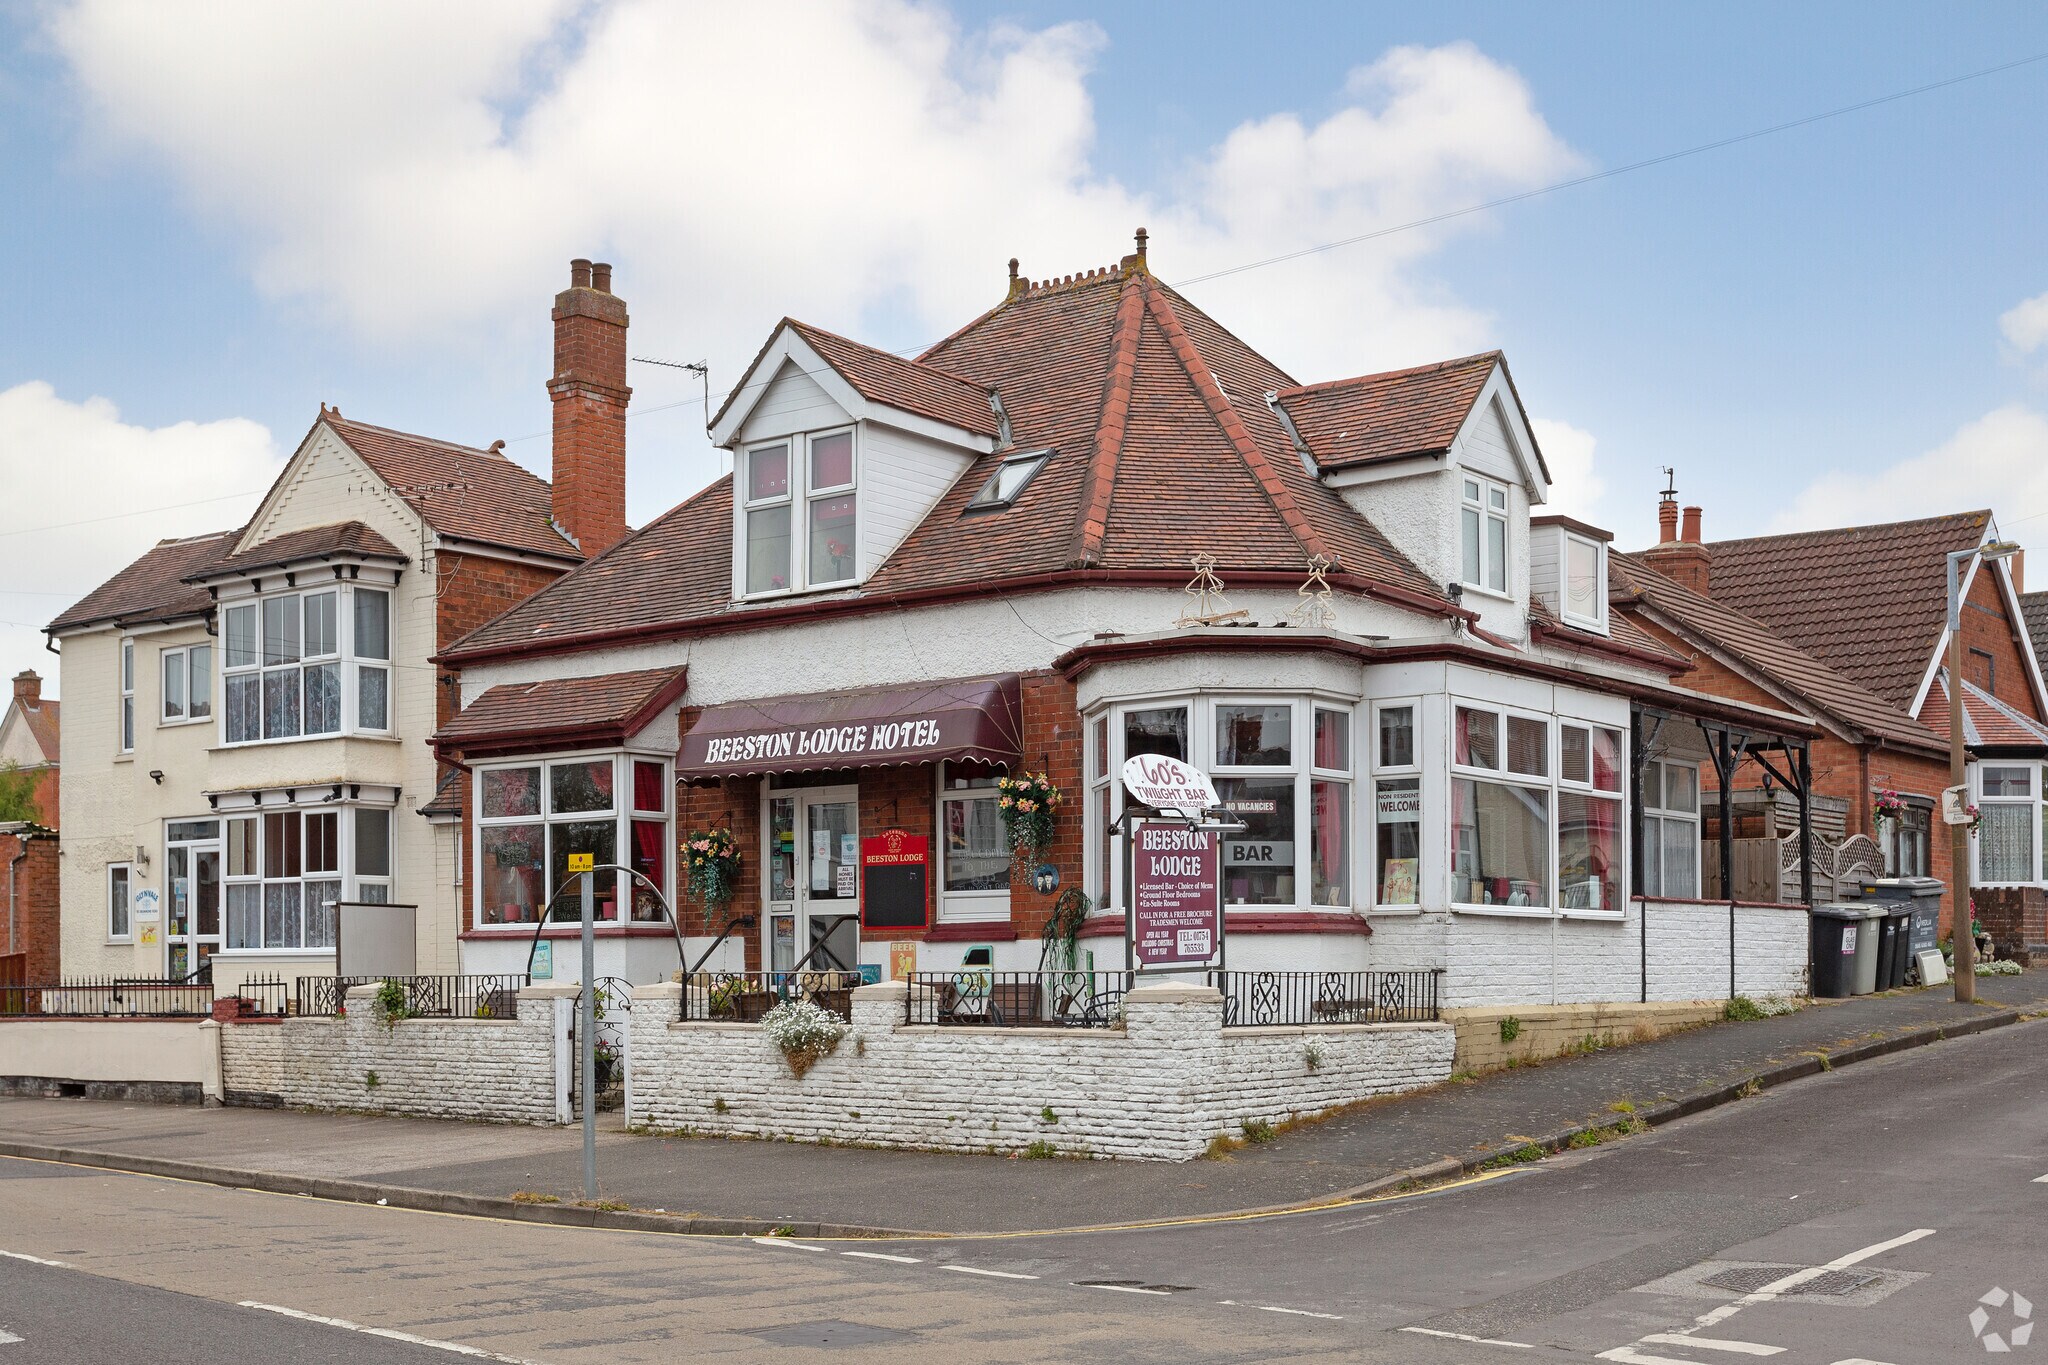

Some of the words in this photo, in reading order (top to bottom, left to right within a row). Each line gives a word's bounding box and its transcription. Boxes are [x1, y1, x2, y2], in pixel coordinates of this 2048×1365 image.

[704, 731, 796, 764] BEESTON
[796, 725, 867, 756] LODGE
[869, 719, 940, 750] HOTEL
[1183, 788, 1210, 801] BAR
[1146, 800, 1177, 808] EVERYONE
[1177, 800, 1207, 808] WELCOME
[1225, 802, 1236, 810] NO
[1237, 801, 1275, 811] VACANCIES
[1380, 800, 1420, 812] WELCOME
[1142, 829, 1209, 851] BEESTON
[866, 855, 899, 863] BEESTON
[900, 853, 924, 862] LODGE
[1232, 845, 1274, 862] BAR
[1151, 855, 1202, 877] LODGE
[1142, 882, 1164, 890] Licensed
[1165, 882, 1175, 890] Bar
[1177, 881, 1194, 890] Choice
[1194, 881, 1200, 889] of
[1200, 881, 1214, 889] Menu
[1142, 891, 1162, 899] Ground
[1176, 890, 1201, 898] Bedrooms
[1142, 900, 1163, 908] En-Suite
[1163, 899, 1180, 907] Rooms
[1139, 911, 1152, 919] CALL
[1153, 911, 1159, 919] IN
[1174, 910, 1187, 918] FREE
[1150, 919, 1179, 927] TRADESMEN
[891, 943, 915, 952] BEER
[1159, 947, 1168, 955] YEAR
